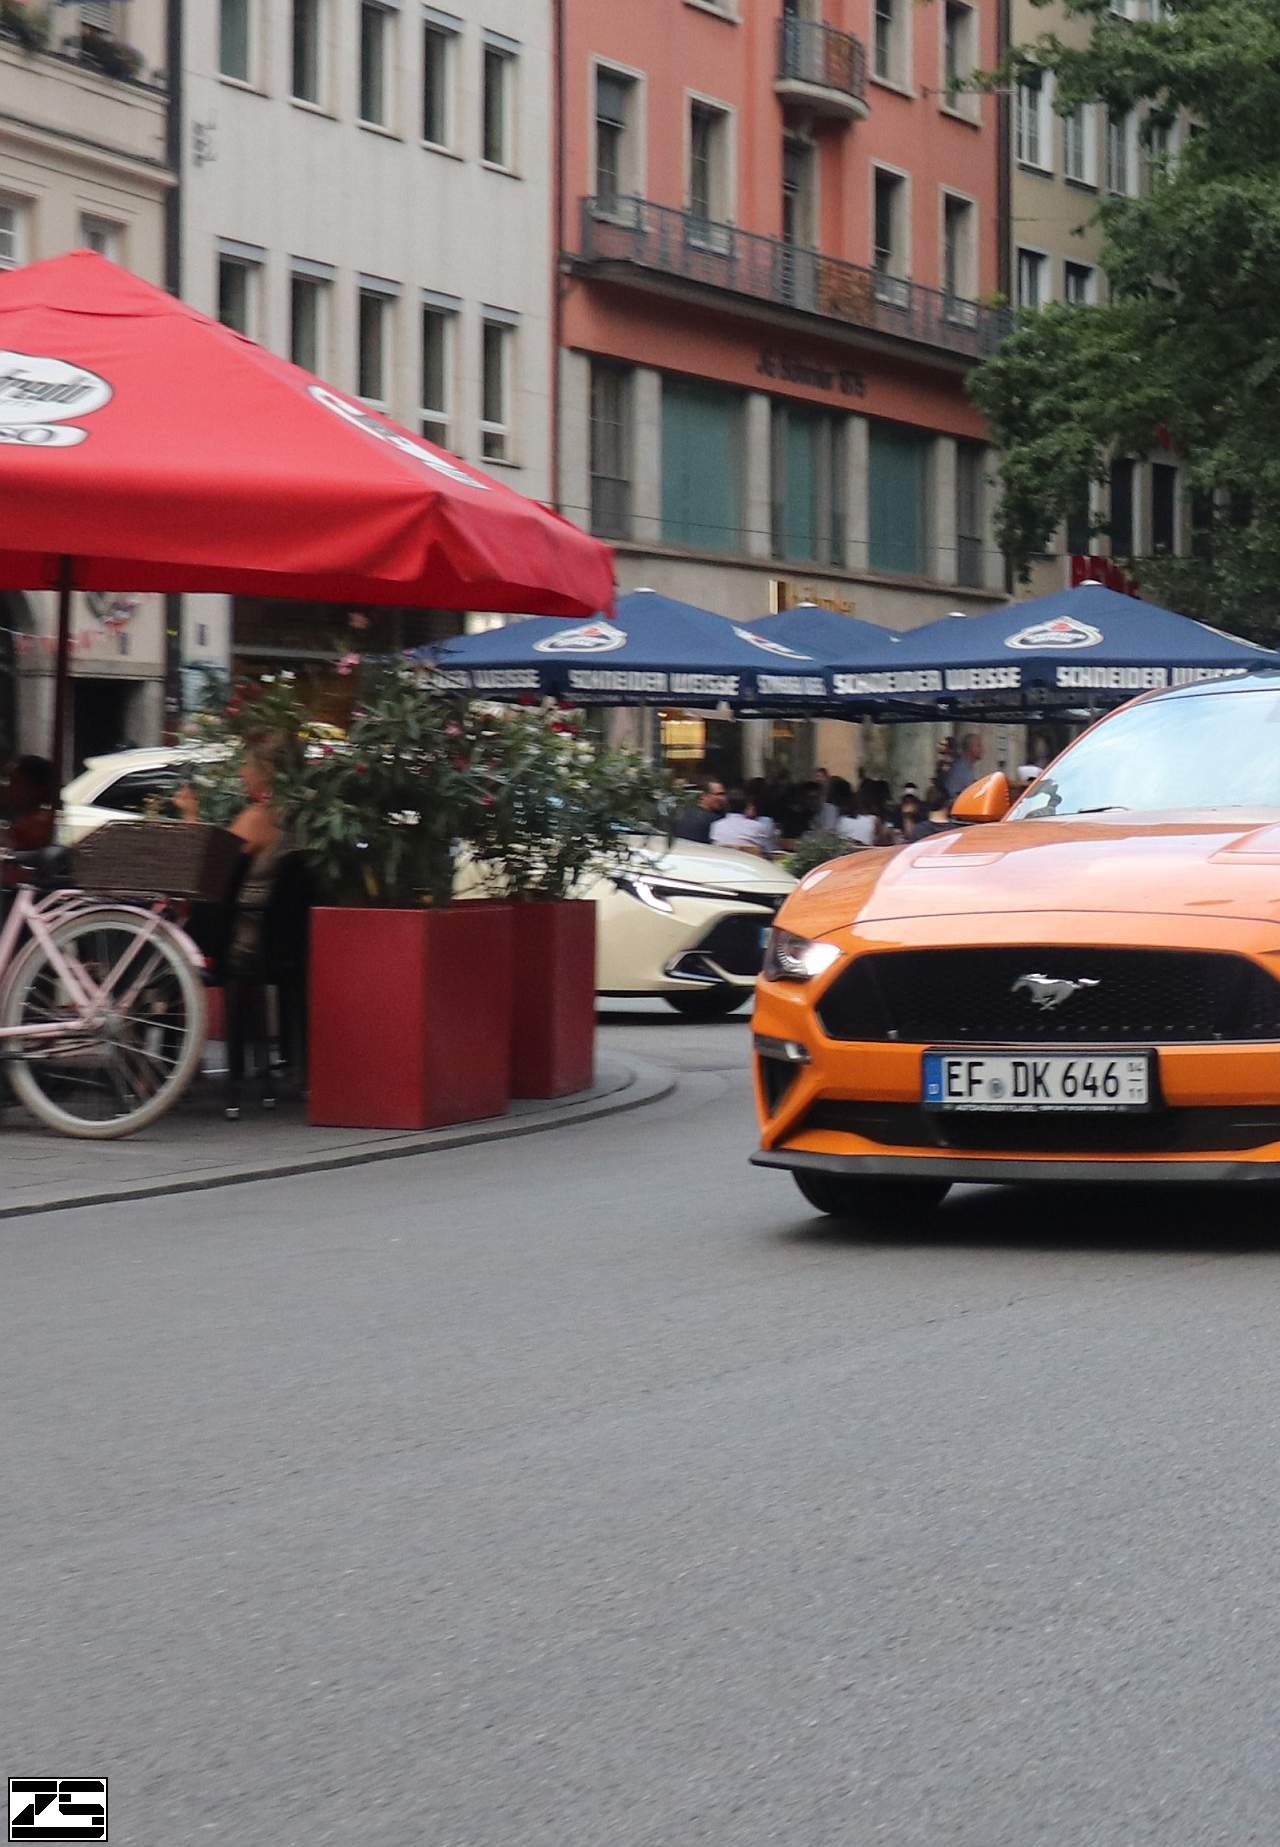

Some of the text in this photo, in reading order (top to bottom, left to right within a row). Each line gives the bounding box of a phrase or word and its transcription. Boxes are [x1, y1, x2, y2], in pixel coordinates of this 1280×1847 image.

[832, 667, 1022, 695] SCHNEIDER WEISSE
[1056, 666, 1168, 689] SCHNEIDER
[947, 1060, 985, 1098] EF
[1011, 1060, 1051, 1098] DK
[1062, 1061, 1120, 1098] 646
